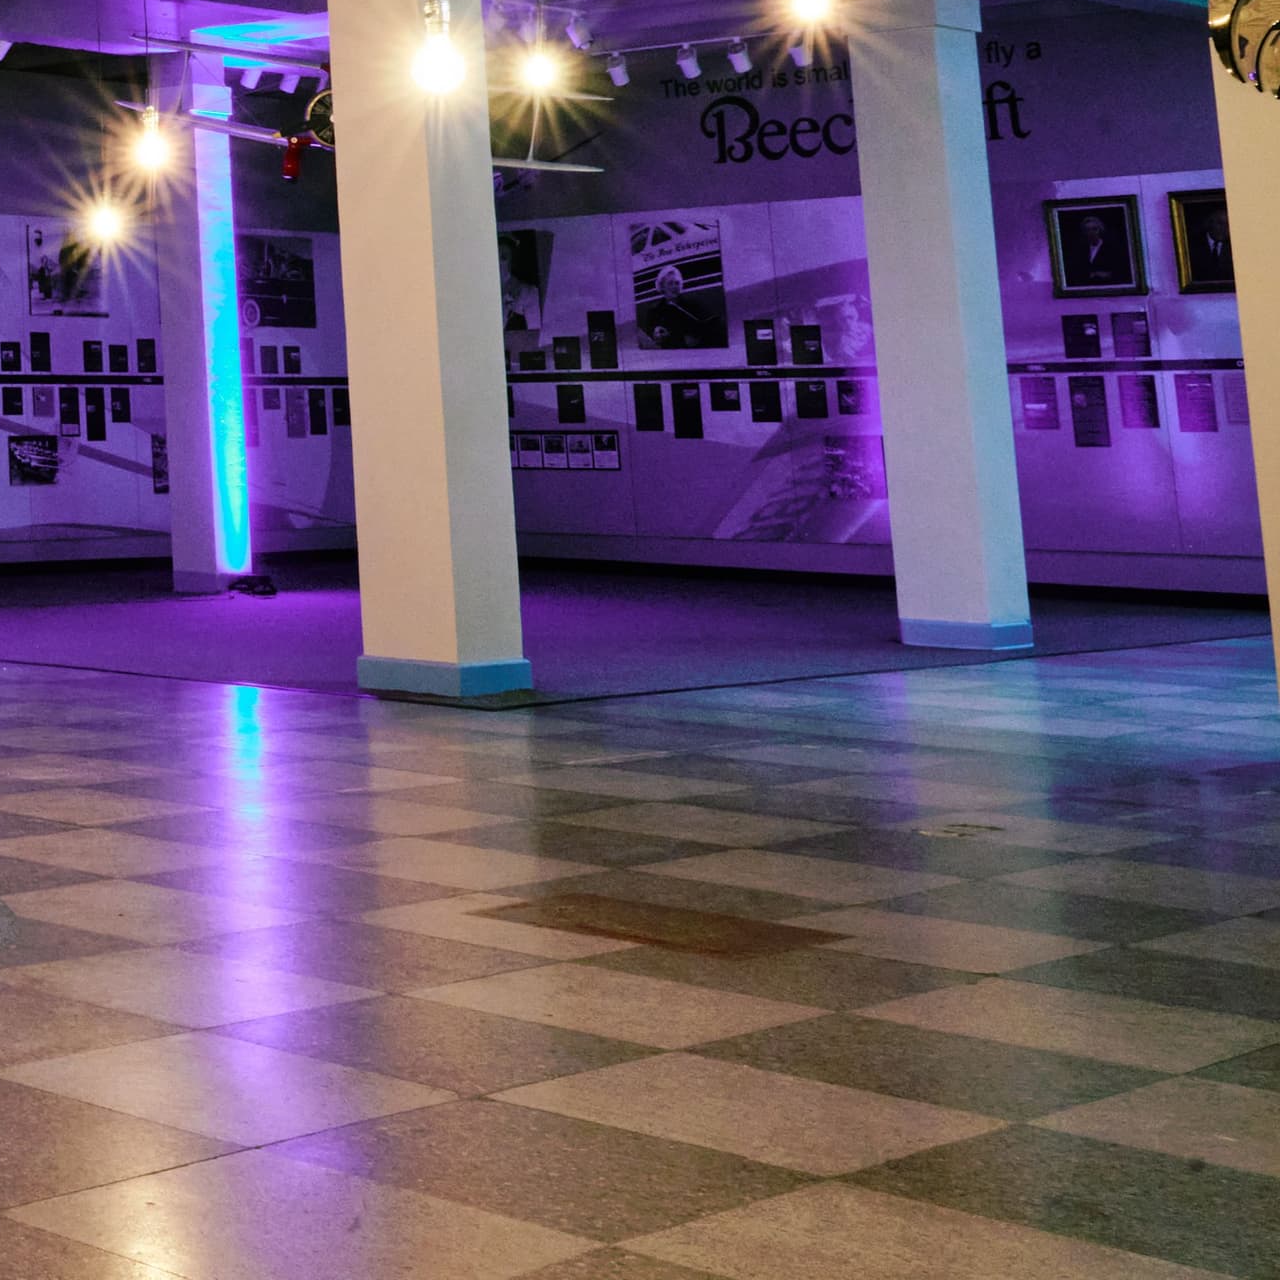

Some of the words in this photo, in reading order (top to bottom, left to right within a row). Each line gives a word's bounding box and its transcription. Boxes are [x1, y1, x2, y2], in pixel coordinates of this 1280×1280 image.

[659, 78, 701, 98] The
[706, 70, 763, 94] world
[771, 68, 789, 89] is
[794, 60, 850, 86] smal
[984, 40, 1015, 68] fly
